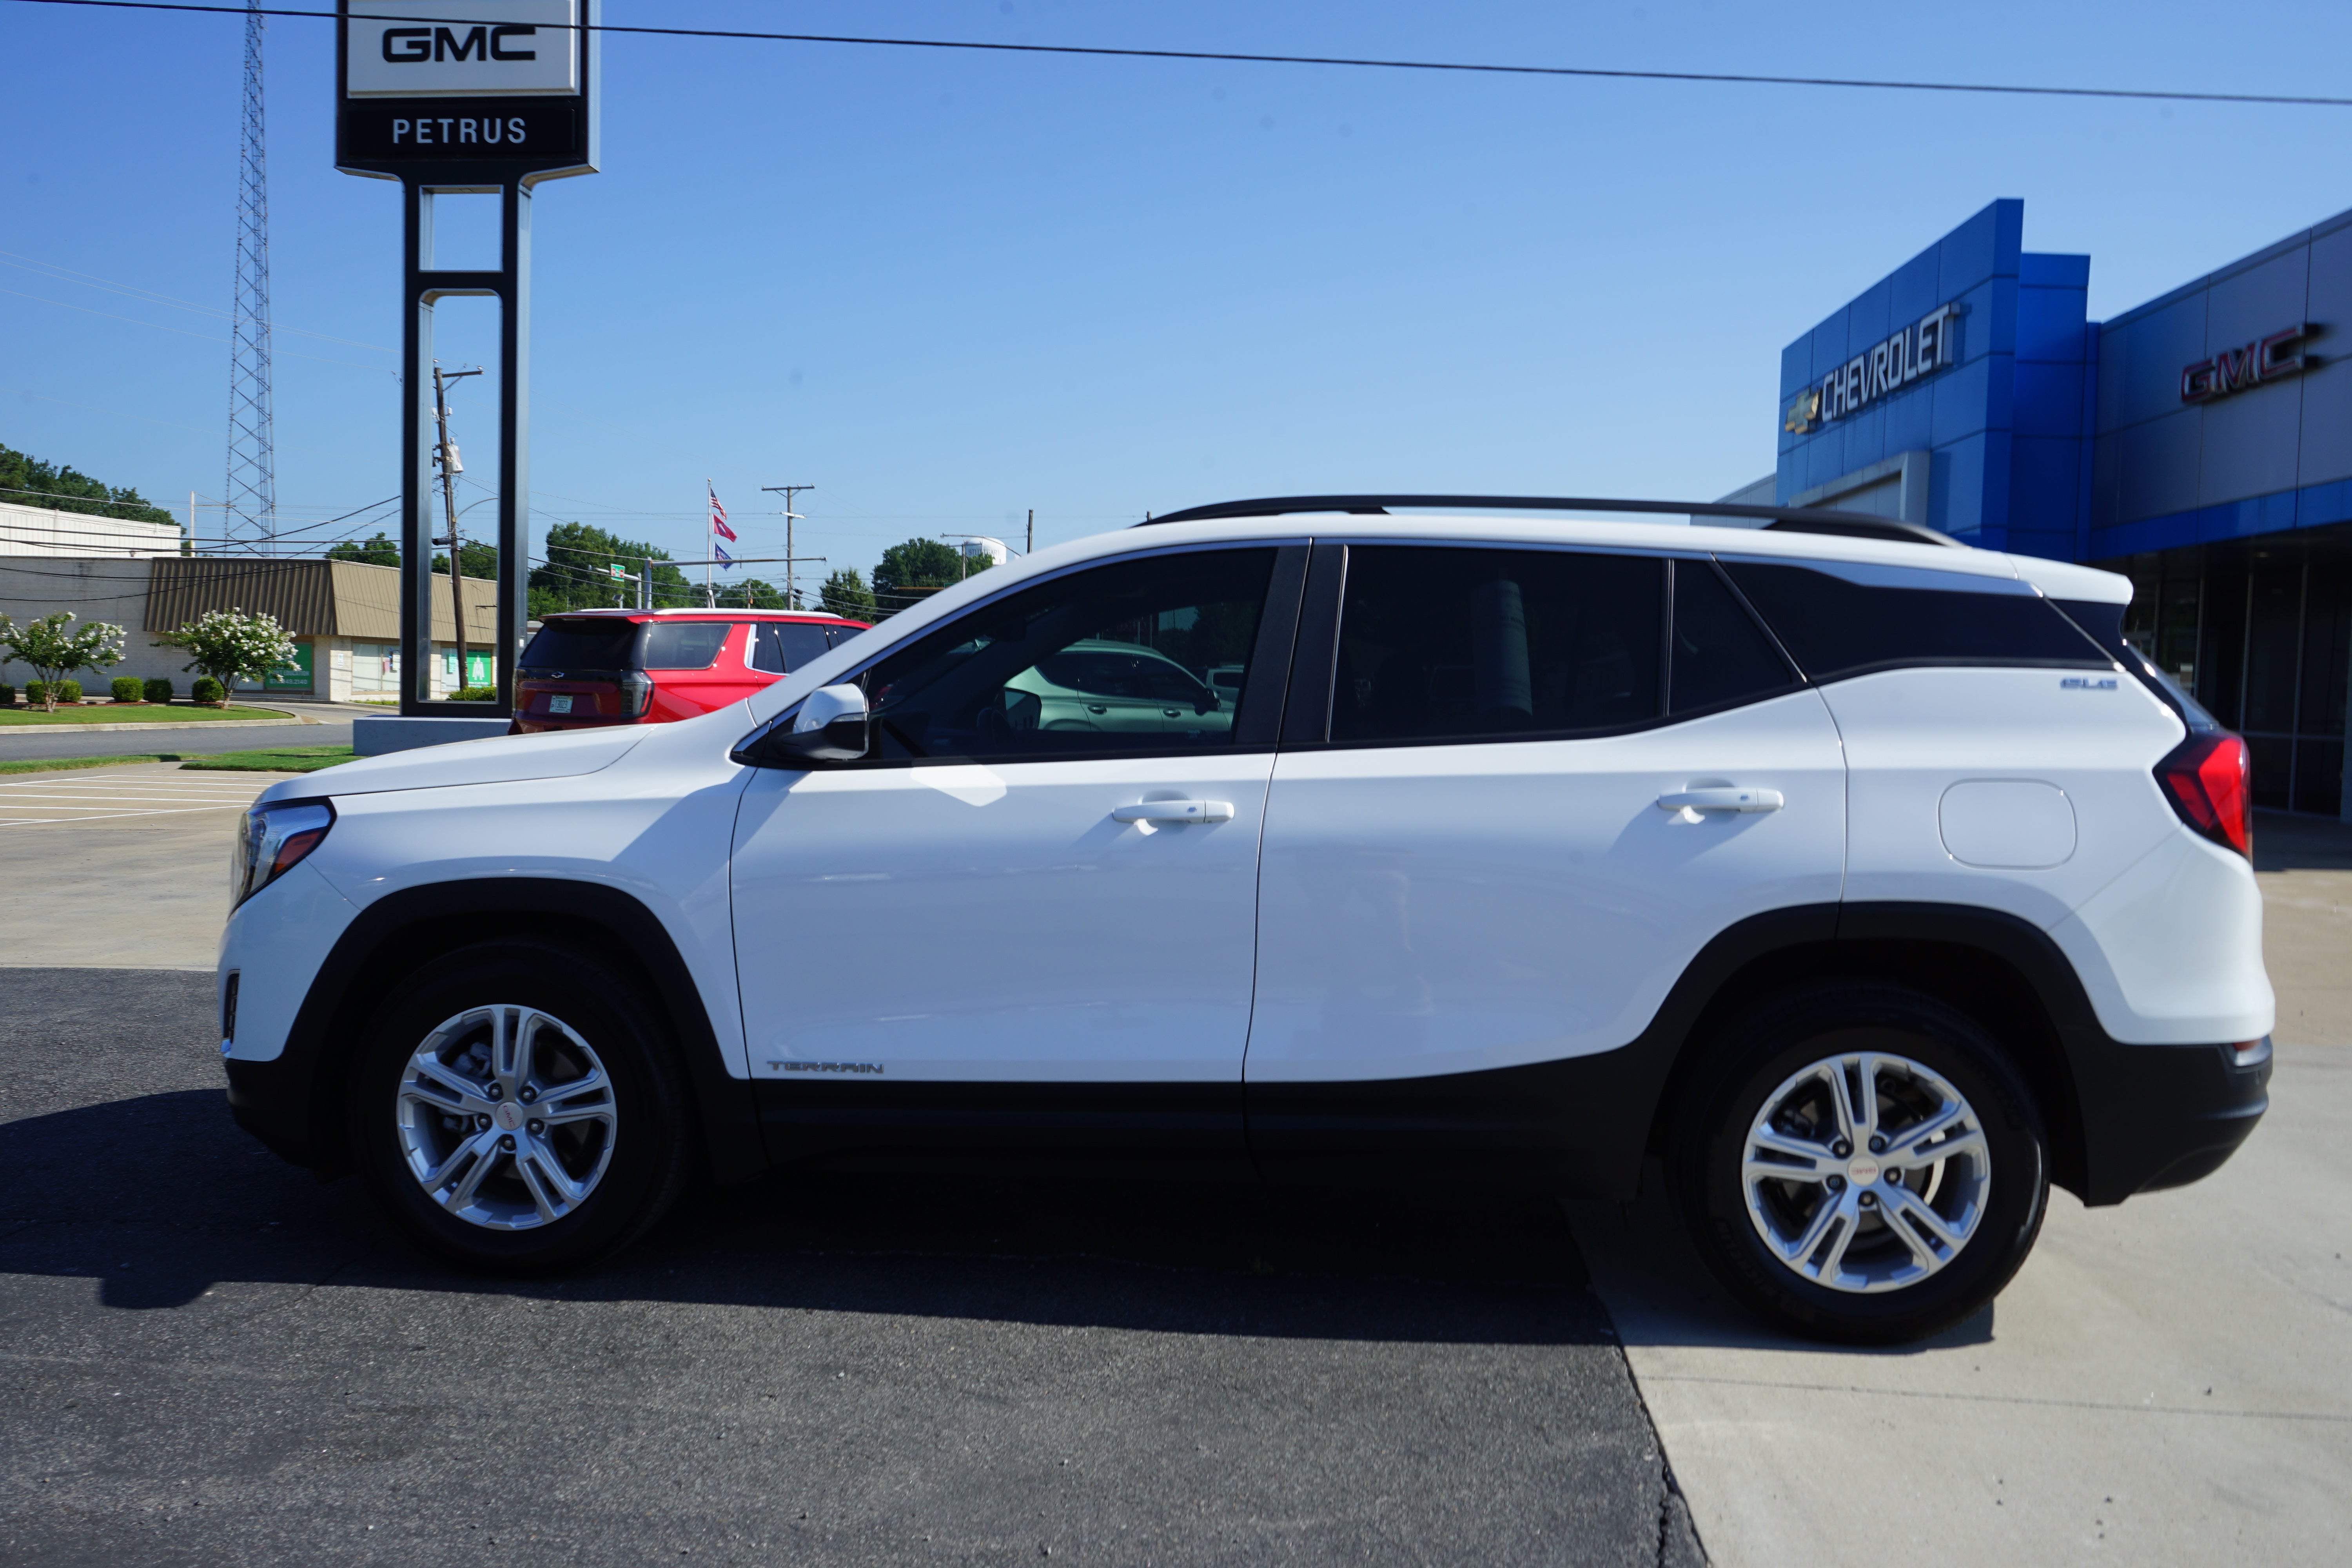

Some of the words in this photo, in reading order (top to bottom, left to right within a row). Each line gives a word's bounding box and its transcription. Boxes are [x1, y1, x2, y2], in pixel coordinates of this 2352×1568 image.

[382, 25, 536, 63] GMC
[393, 118, 526, 144] PETRUS
[1822, 302, 1952, 423] CHEVROLET
[2181, 325, 2303, 403] GMC
[767, 1061, 884, 1073] TERRAIN
[503, 1105, 515, 1128] GMC
